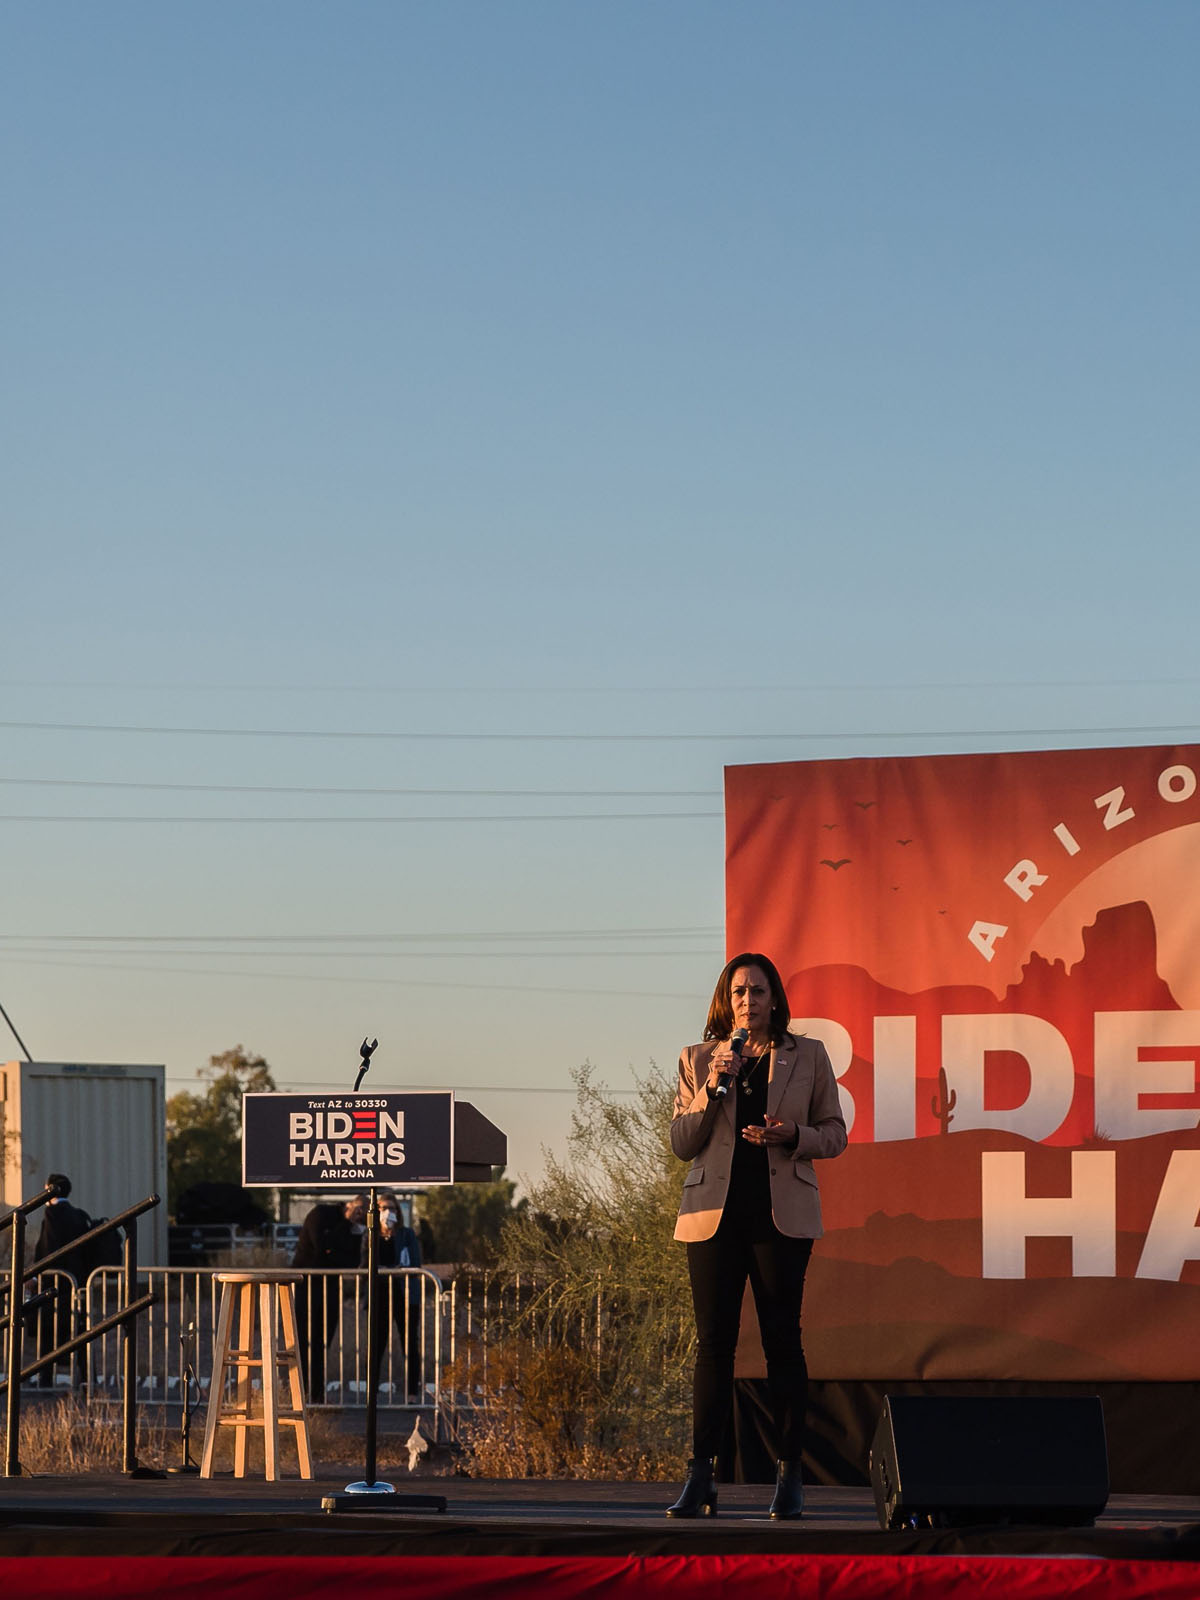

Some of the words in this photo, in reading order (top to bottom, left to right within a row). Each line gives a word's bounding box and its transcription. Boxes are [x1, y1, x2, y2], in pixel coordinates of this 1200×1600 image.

[307, 1101, 326, 1109] Text
[327, 1100, 343, 1109] AZ
[344, 1101, 353, 1109] to
[354, 1099, 388, 1109] 30330
[289, 1111, 405, 1140] BIDEN
[289, 1143, 406, 1166] HARRIS
[320, 1169, 375, 1179] ARIZONA
